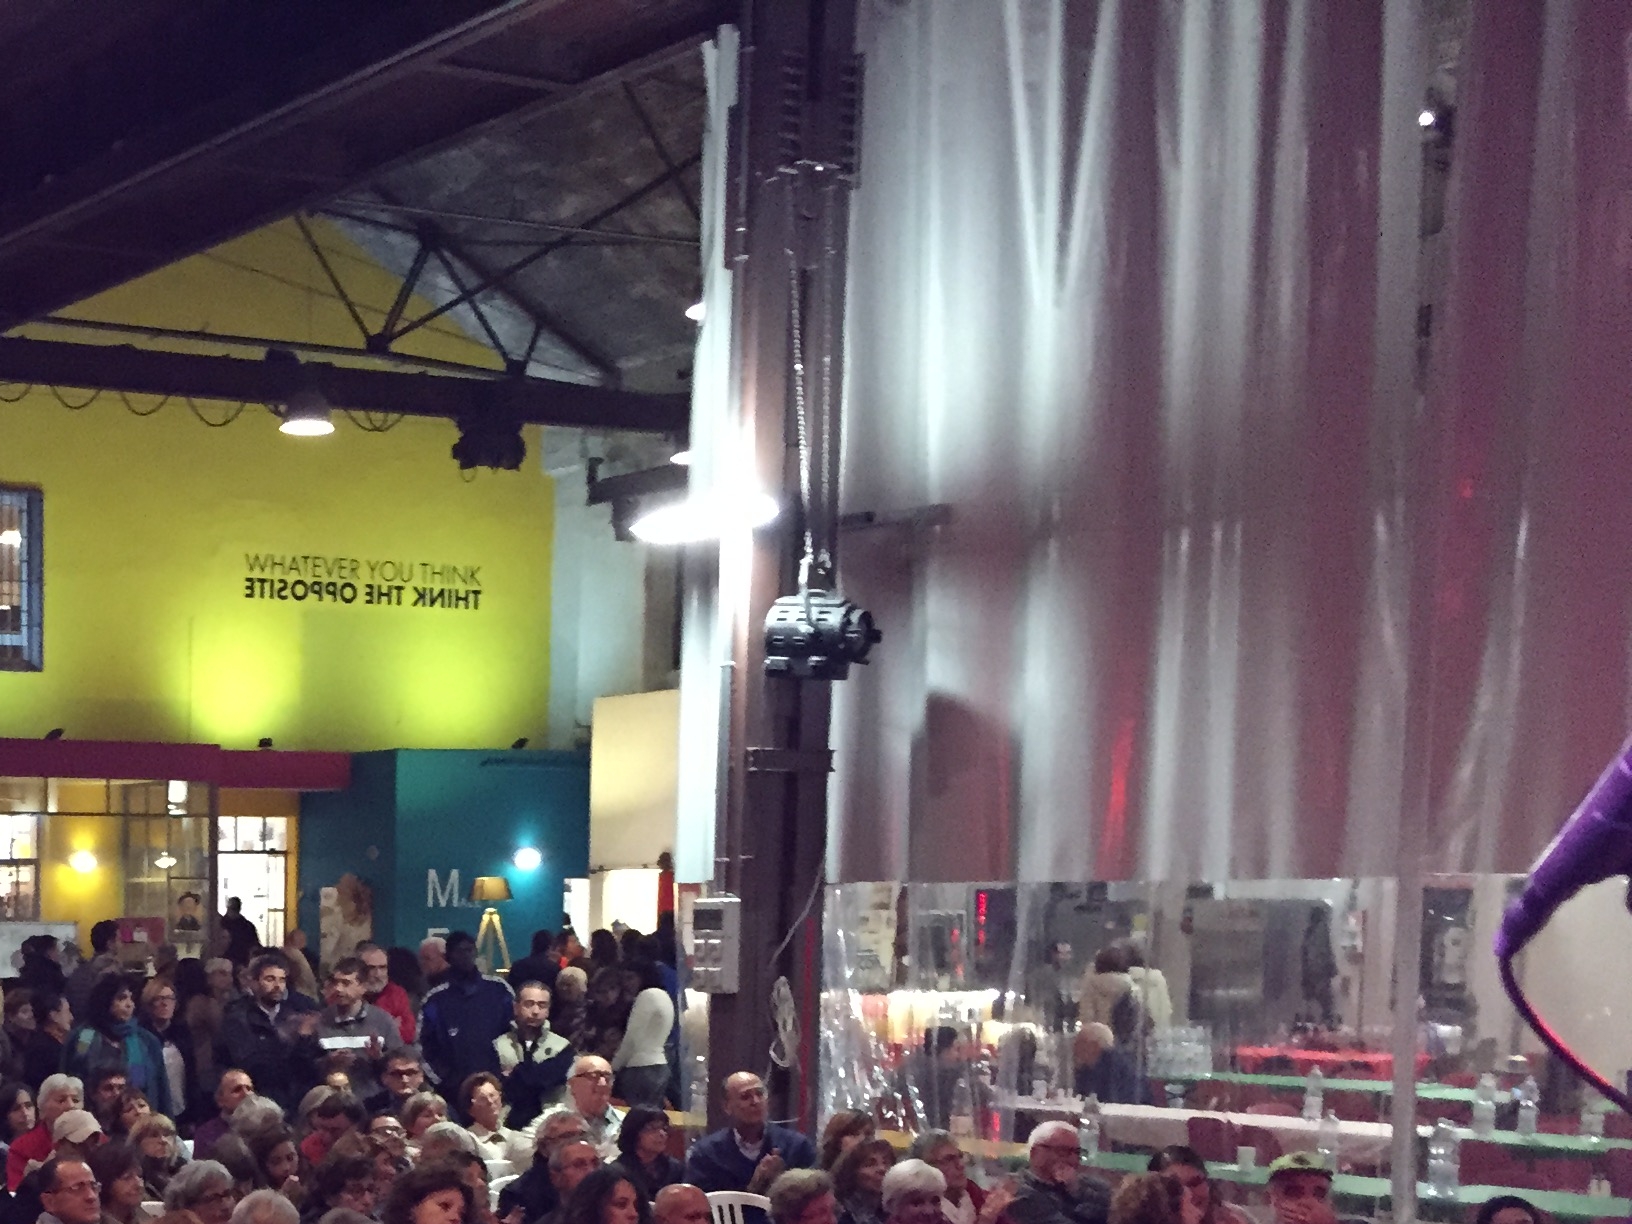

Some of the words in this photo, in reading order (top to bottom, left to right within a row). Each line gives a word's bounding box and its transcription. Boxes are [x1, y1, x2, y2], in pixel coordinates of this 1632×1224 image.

[245, 553, 361, 580] WHATEVER
[365, 560, 415, 582] YOU
[419, 562, 482, 586] THINK
